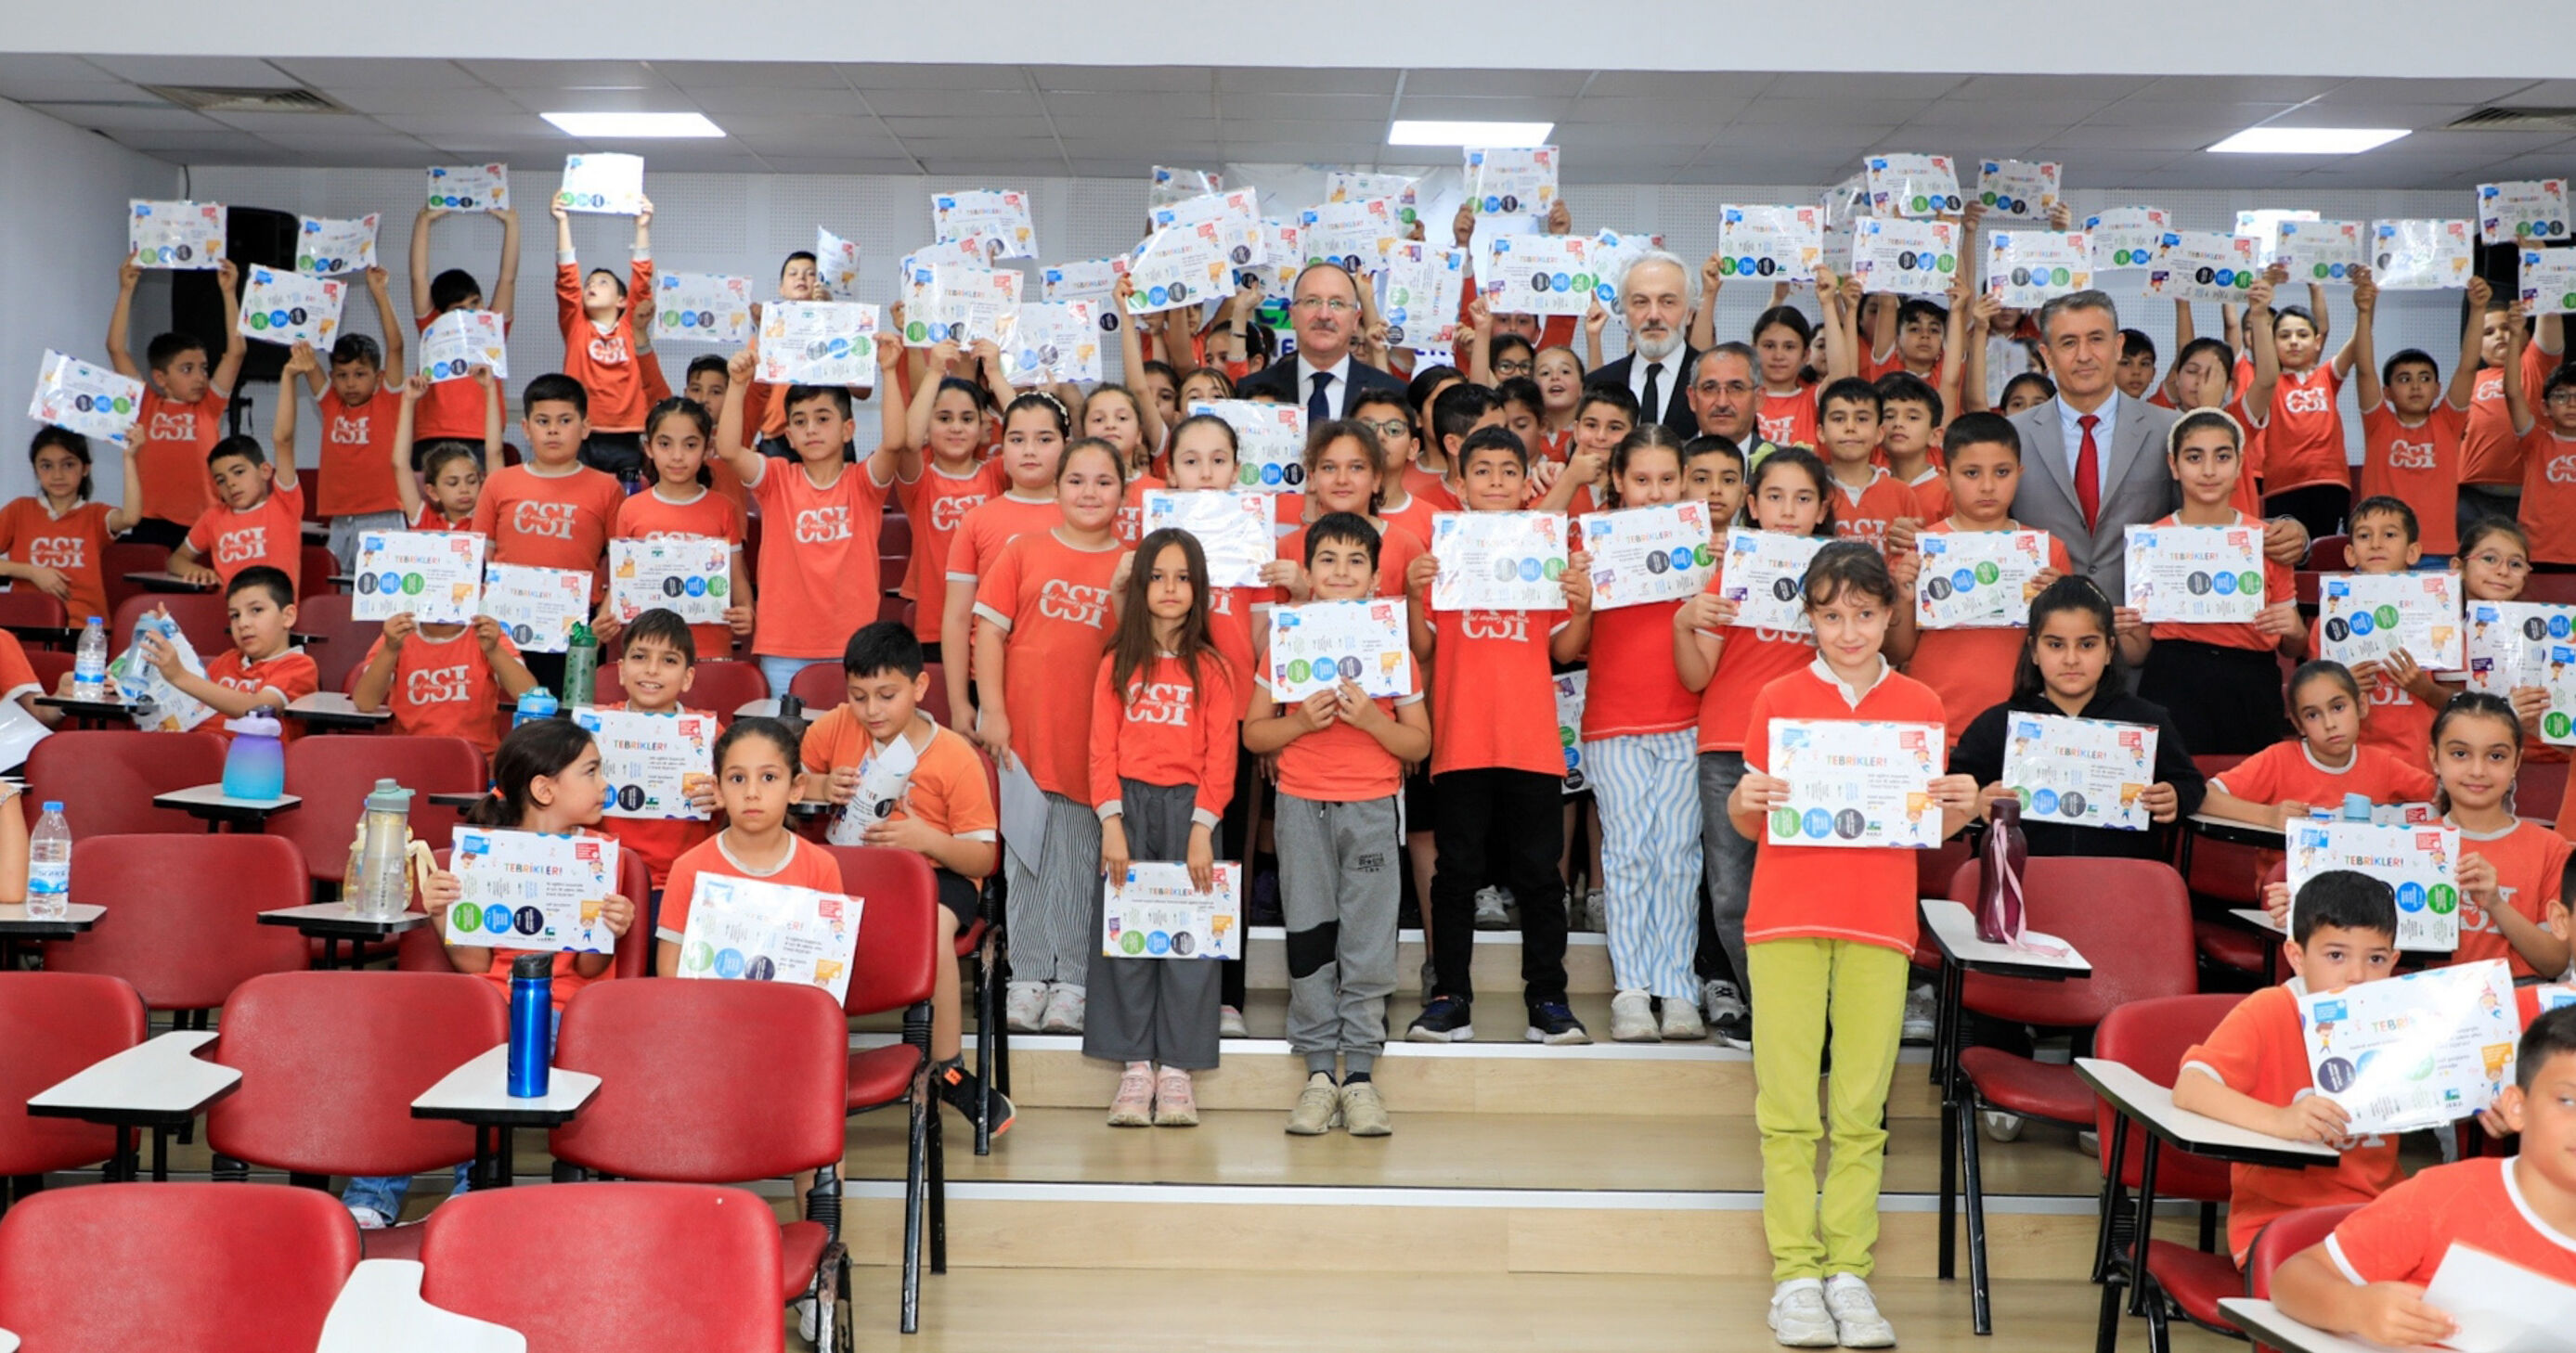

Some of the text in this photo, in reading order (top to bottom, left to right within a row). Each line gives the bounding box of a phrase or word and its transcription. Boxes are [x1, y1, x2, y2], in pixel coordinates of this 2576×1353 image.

[589, 337, 629, 363] CSI
[2285, 387, 2329, 413] CSI
[149, 412, 196, 441] CSI
[331, 416, 369, 444] CSI
[2388, 439, 2436, 468] CSI
[2546, 456, 2576, 483] CS
[513, 500, 577, 538] CSI
[796, 506, 852, 542] CSI
[31, 537, 84, 567] CSI
[219, 526, 265, 562] CSI
[1040, 579, 1111, 629] CSI
[1462, 609, 1529, 641] CSI
[408, 665, 470, 704] CSI
[1126, 682, 1193, 727] CSI
[615, 740, 667, 751] TEBRİKLER!
[2054, 746, 2106, 759] TEBRİKLER!
[1827, 754, 1886, 767] TEBRİKLER!
[2345, 855, 2403, 867] TEBRİKLER!
[1149, 887, 1193, 896] TEBRİKLER
